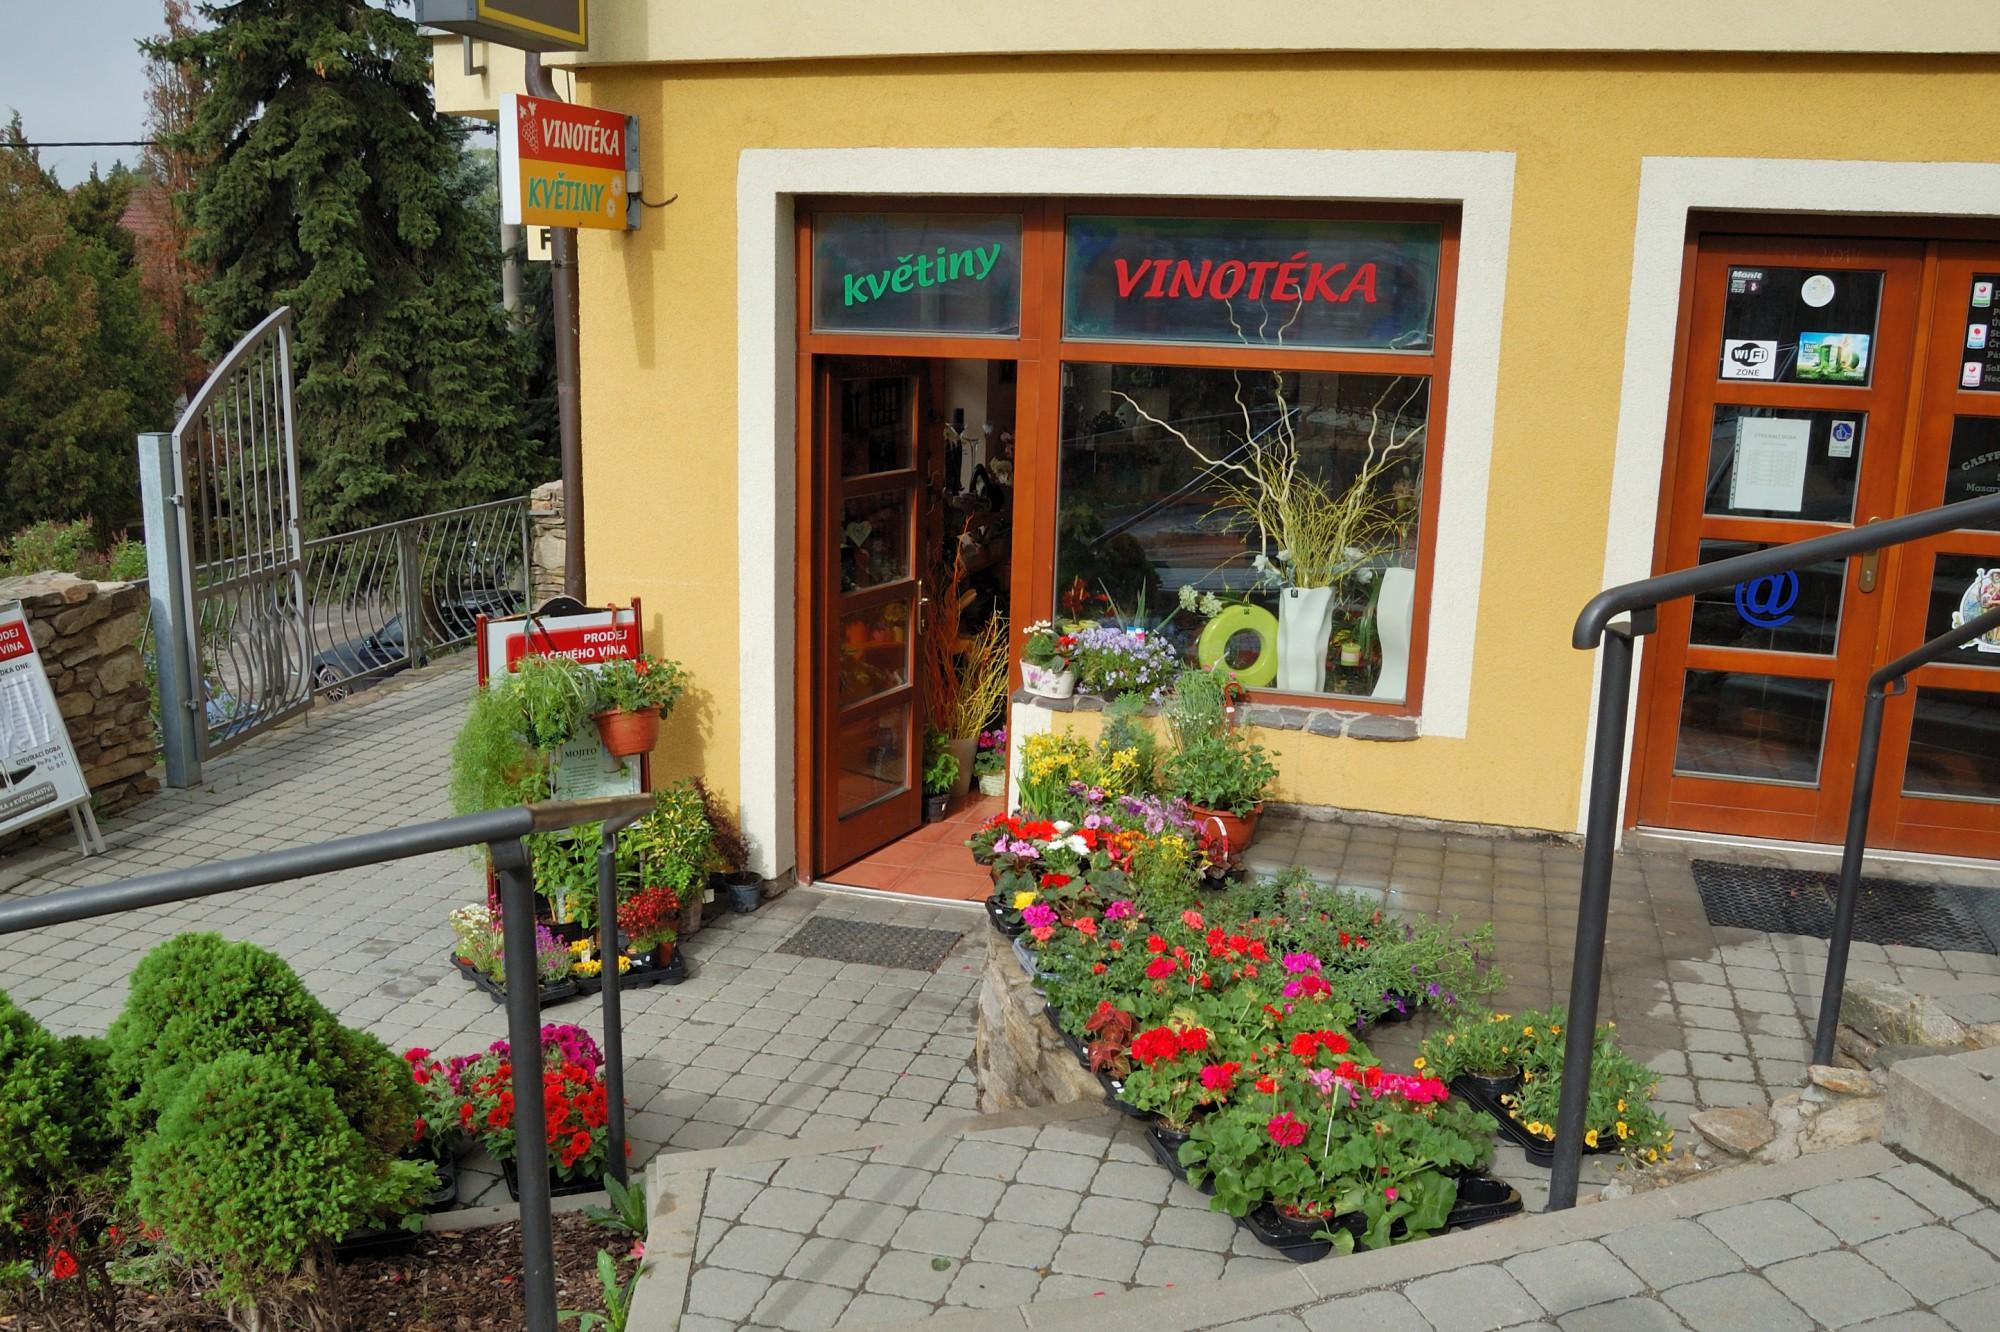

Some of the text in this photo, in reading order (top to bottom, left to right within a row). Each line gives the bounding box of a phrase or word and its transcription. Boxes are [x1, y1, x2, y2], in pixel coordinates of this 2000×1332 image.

[542, 118, 621, 157] VINOTÉKA
[528, 172, 606, 213] KVĚTINY
[844, 243, 1001, 306] květiny
[1114, 251, 1378, 303] VINOTÉKA
[1735, 368, 1761, 377] ZONE
[583, 629, 628, 644] PRODEJ
[598, 643, 628, 656] VÍNA
